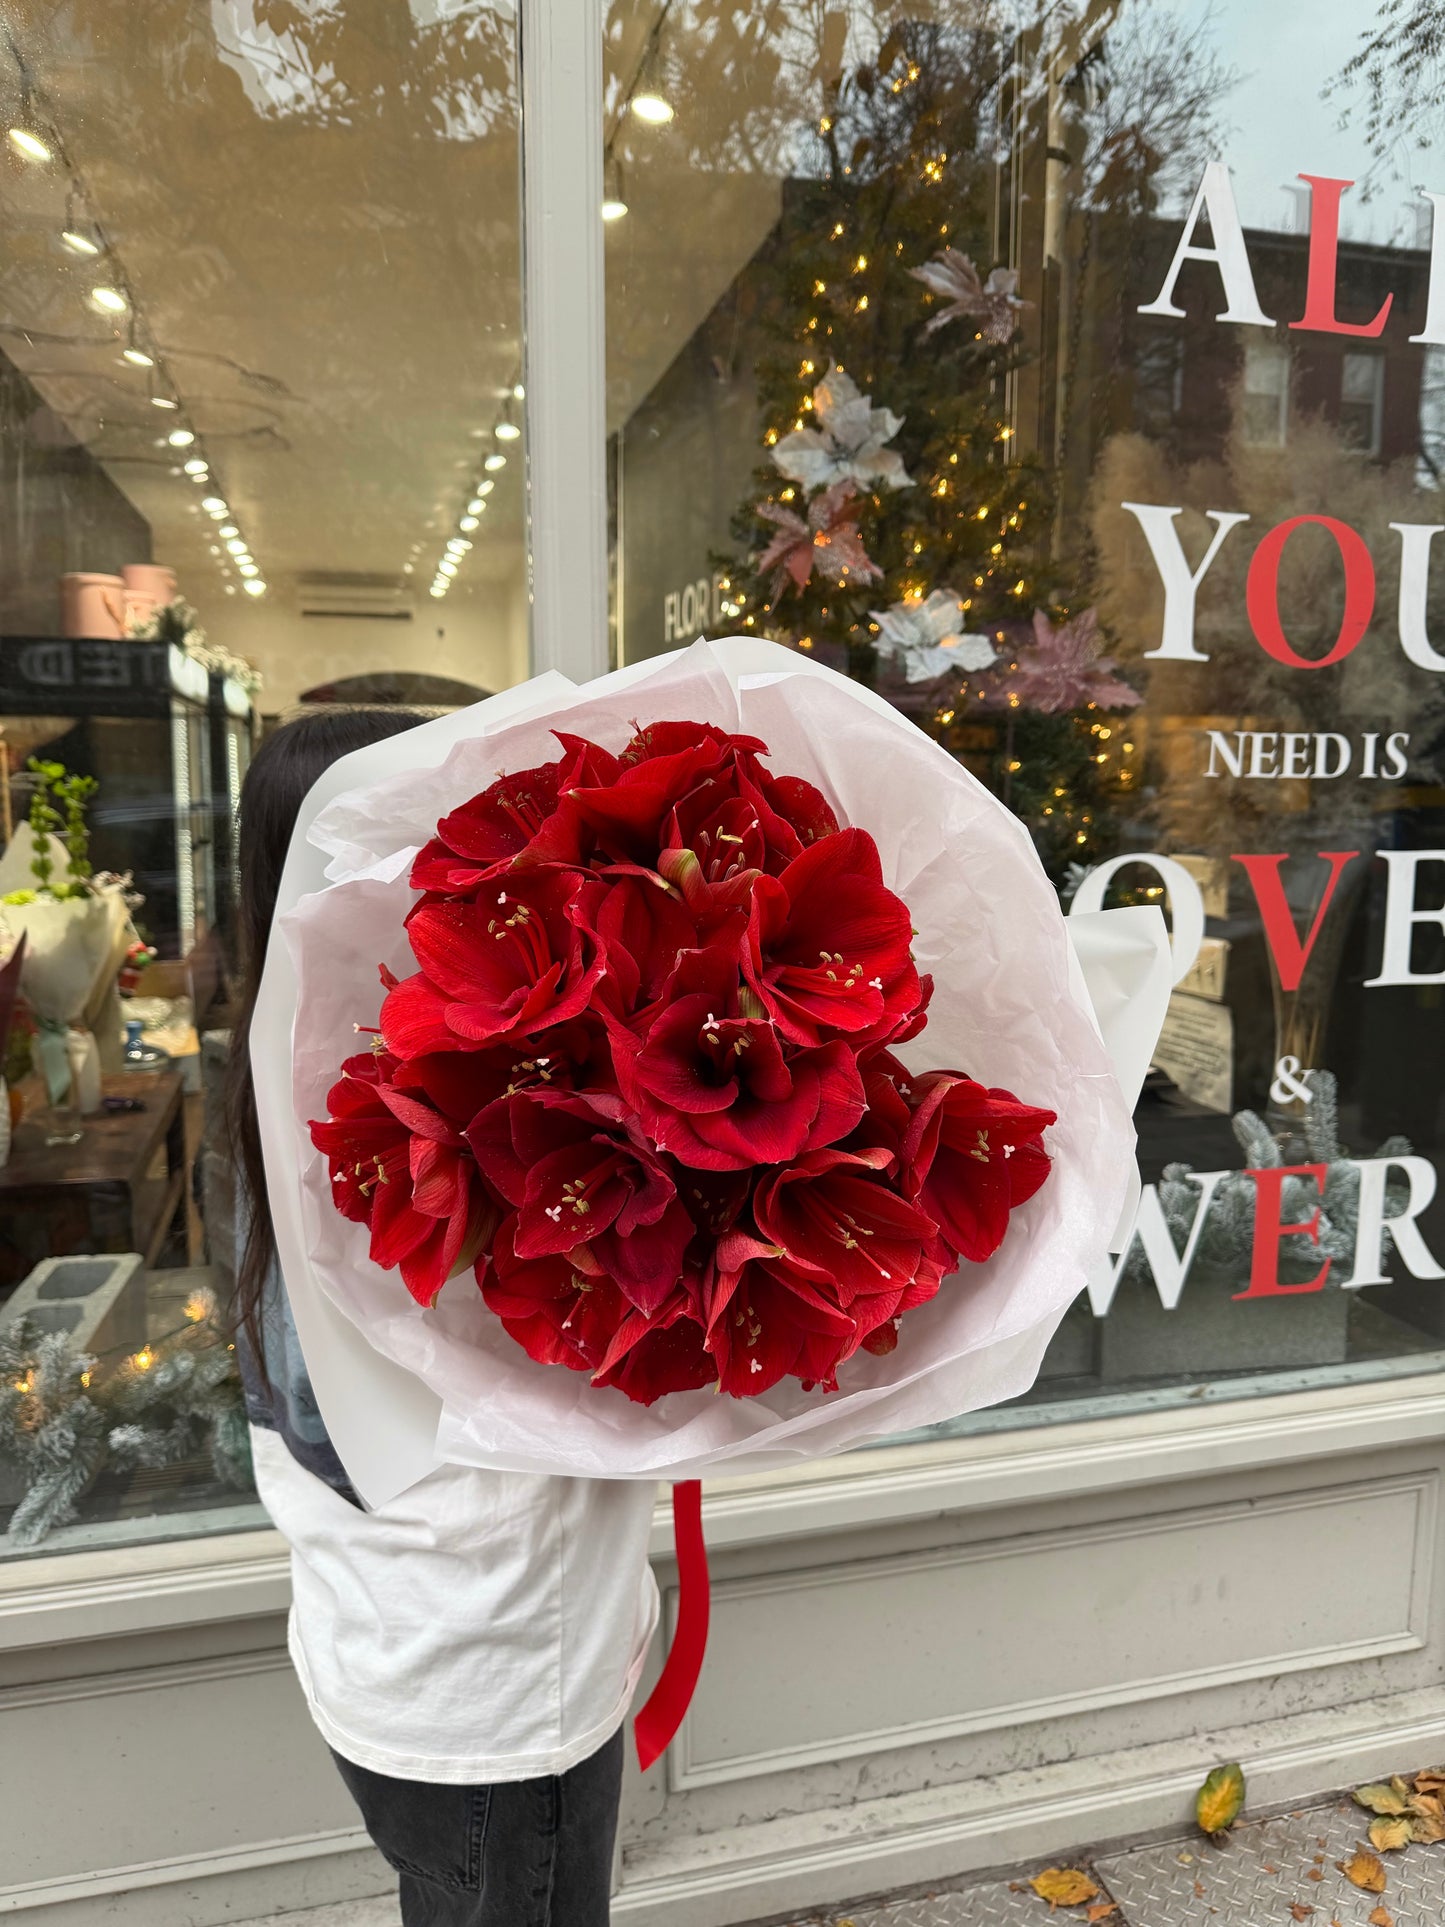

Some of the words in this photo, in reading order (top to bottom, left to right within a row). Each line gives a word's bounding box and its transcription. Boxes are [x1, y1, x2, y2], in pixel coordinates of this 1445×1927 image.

[1137, 160, 1445, 344] AL
[1203, 730, 1352, 779] NEED
[1360, 732, 1410, 780] IS
[1270, 1054, 1314, 1105] &
